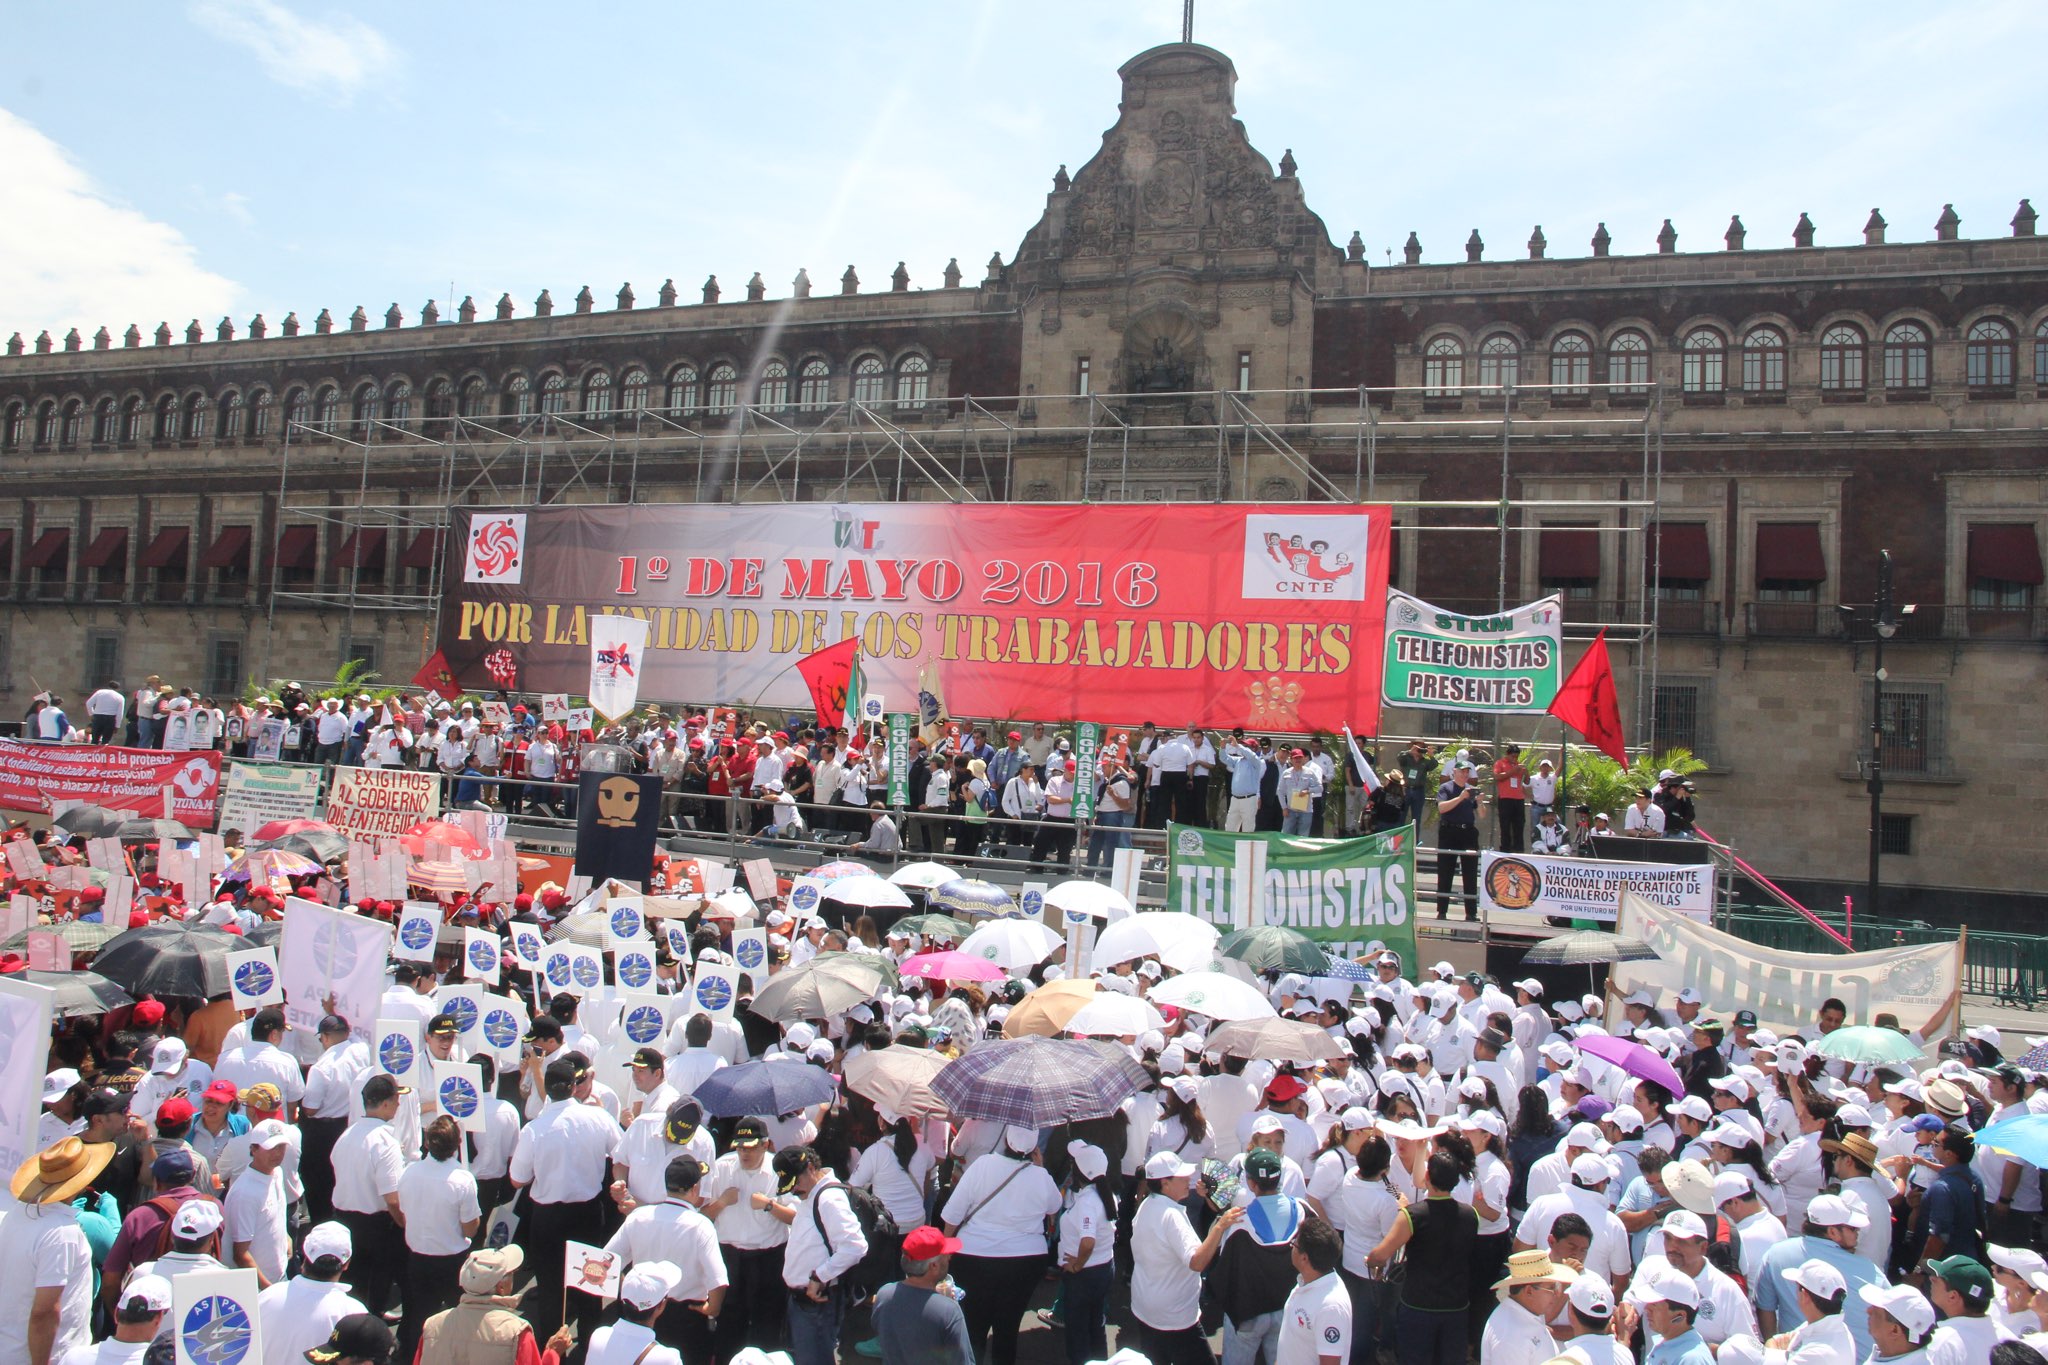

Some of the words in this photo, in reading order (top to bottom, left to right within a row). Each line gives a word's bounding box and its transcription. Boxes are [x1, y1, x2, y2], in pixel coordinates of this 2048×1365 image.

[684, 557, 765, 597] DE
[779, 557, 964, 602] MAYO
[981, 559, 1159, 608] 2016
[1275, 580, 1335, 594] CNTE
[1434, 614, 1514, 632] STRM
[458, 601, 533, 646] POR
[542, 603, 589, 648] LA
[601, 605, 760, 653] NIDAD
[769, 609, 828, 655] DE
[936, 613, 1352, 674] TRABAJADORES
[1396, 636, 1549, 669] TELEFONISTAS
[1407, 671, 1533, 705] PRESENTES
[28, 748, 40, 757] la
[109, 754, 116, 763] a
[118, 751, 128, 764] la
[892, 728, 908, 805] GUARDERIAS
[23, 776, 36, 786] no
[354, 768, 431, 791] EXIGIMOS
[1075, 739, 1095, 819] GUARDERIAS
[338, 784, 354, 805] AL
[358, 788, 429, 813] GOBIERNO
[327, 804, 349, 826] QUE
[1545, 874, 1601, 890] NACIONAL
[1686, 882, 1701, 894] DE
[1546, 865, 1604, 879] SINDICATO
[1607, 870, 1698, 882] INDEPENDIENTE
[1176, 864, 1407, 928] TELONISTAS
[1544, 886, 1615, 902] JORNALEROS
[1635, 892, 1681, 906] ICOLAS
[1583, 906, 1607, 914] FUTURO
[108, 1073, 142, 1083] telcel
[737, 1128, 752, 1136] ASPA
